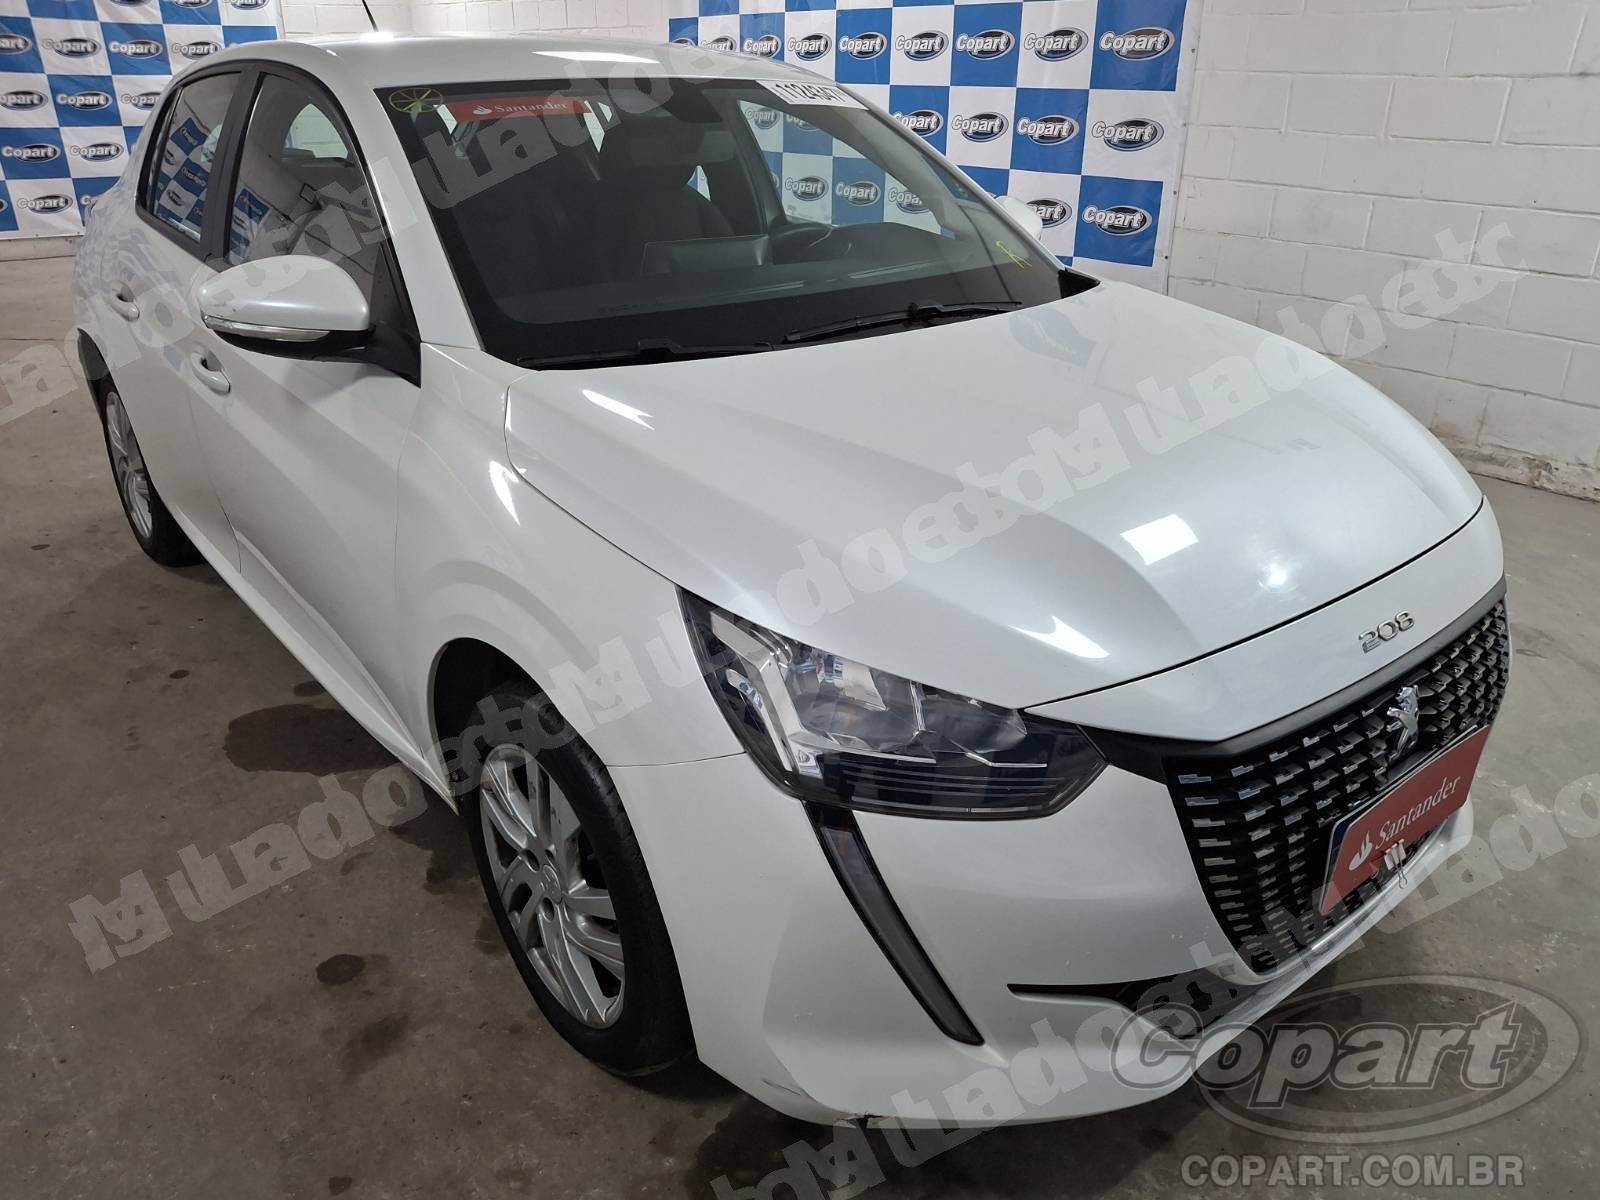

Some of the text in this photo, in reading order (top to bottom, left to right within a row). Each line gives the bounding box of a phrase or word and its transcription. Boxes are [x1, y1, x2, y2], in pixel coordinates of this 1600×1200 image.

[43, 39, 94, 55] Copart
[109, 41, 157, 55] Copart
[172, 43, 216, 55] Copart
[743, 39, 776, 55] Copart
[787, 37, 826, 55] Copart
[838, 37, 883, 55] Copart
[895, 35, 943, 56] Copart
[956, 33, 1009, 53] Copart
[1024, 32, 1079, 54] Copart
[1100, 31, 1166, 55] Copart
[56, 93, 107, 106] Copart
[495, 101, 567, 113] Santander
[747, 109, 775, 123] Copart
[951, 114, 1003, 136] Copart
[1017, 118, 1073, 139] Copart
[1092, 121, 1155, 144] Copart
[2, 145, 55, 158] Copart
[70, 143, 117, 157] Copart
[785, 178, 825, 196] Copart
[835, 183, 877, 201] Copart
[17, 198, 70, 212] Copart
[1083, 205, 1145, 230] Copart
[1358, 610, 1416, 654] 208
[1375, 776, 1462, 851] Santander
